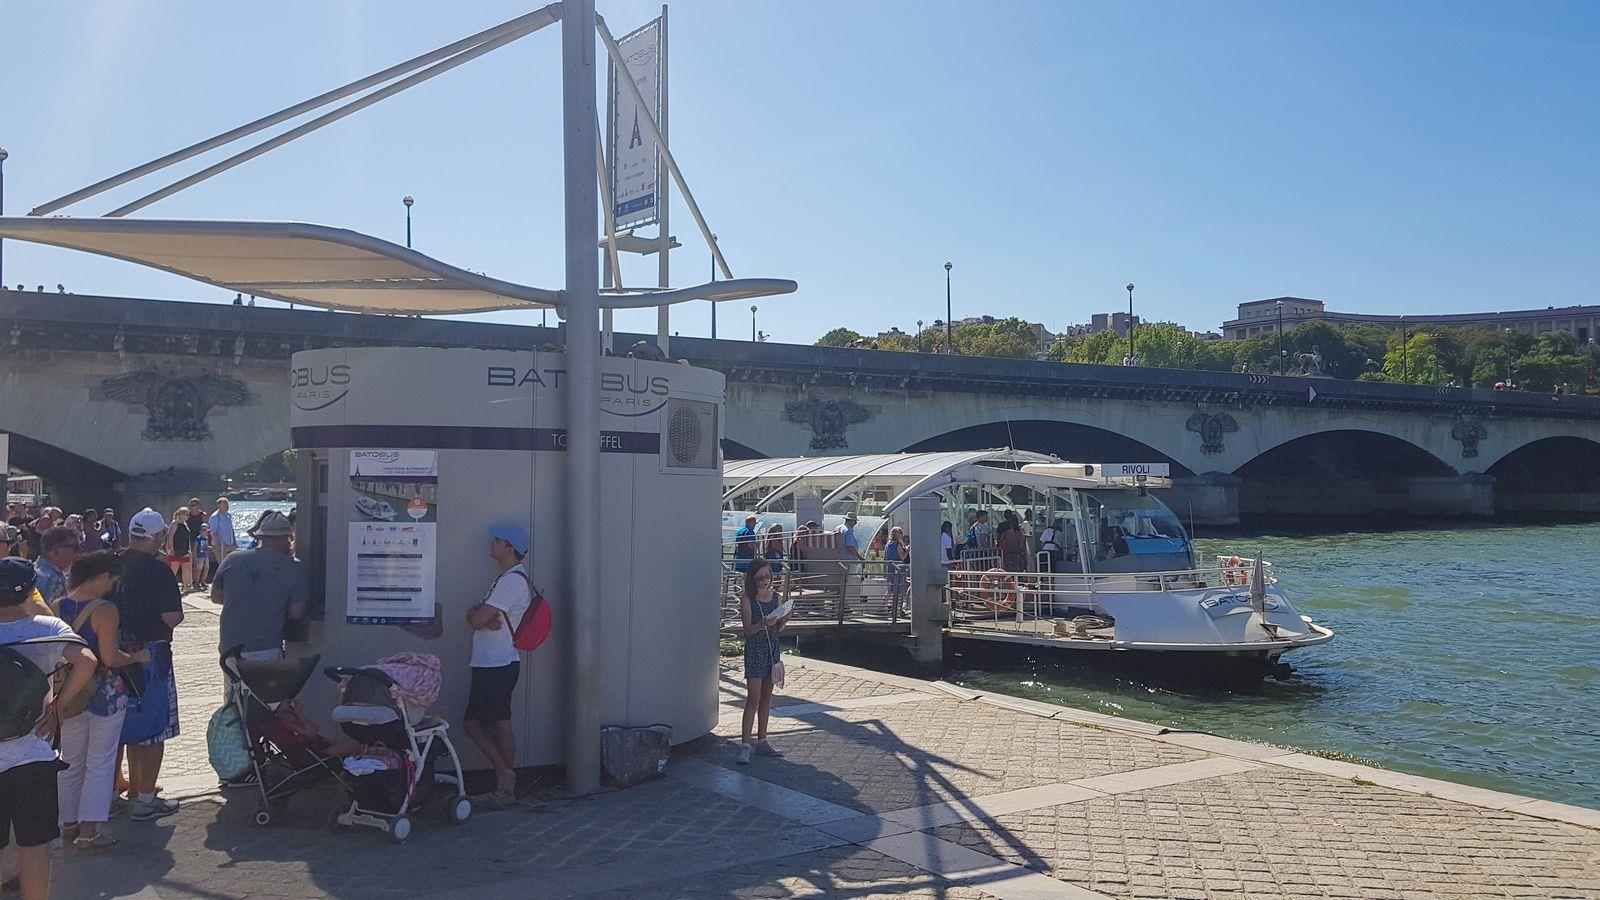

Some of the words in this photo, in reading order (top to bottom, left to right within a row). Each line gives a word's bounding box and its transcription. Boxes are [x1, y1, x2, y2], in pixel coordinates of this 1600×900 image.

[487, 366, 669, 396] BATBUS
[600, 396, 651, 407] PARIS
[600, 435, 622, 449] FFEL
[1121, 464, 1150, 475] RIVOLI
